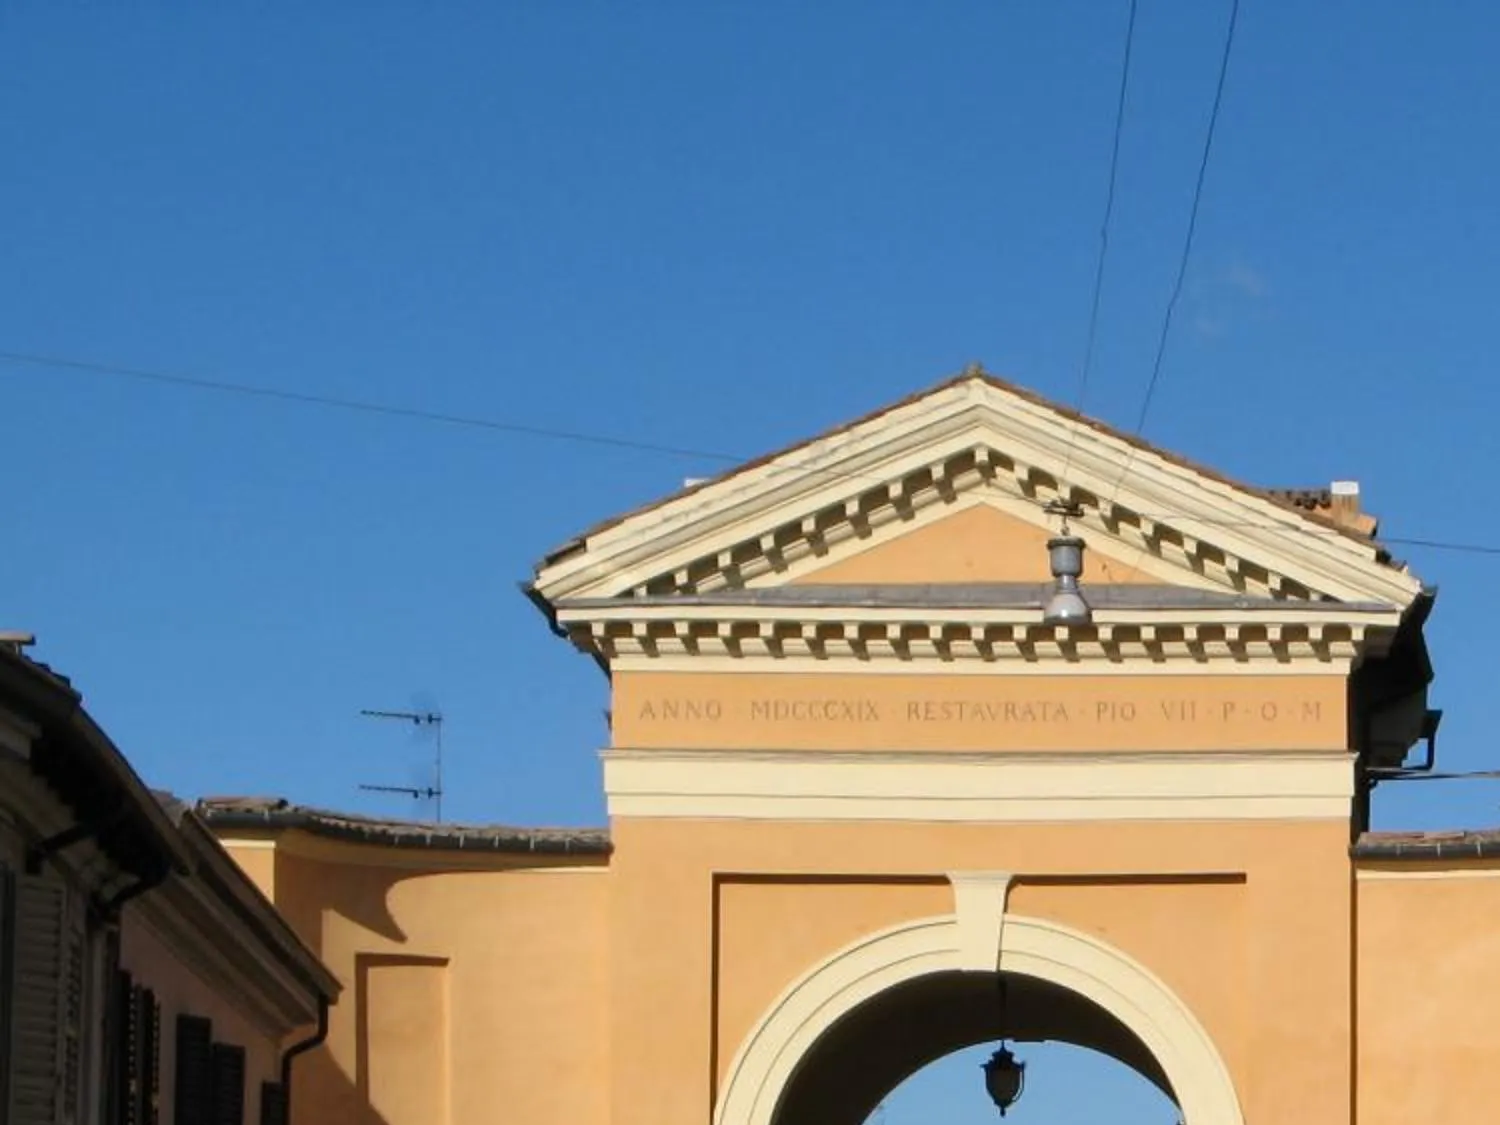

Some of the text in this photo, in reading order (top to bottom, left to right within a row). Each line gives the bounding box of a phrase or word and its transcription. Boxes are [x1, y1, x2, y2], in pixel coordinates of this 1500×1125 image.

[639, 699, 723, 721] ANNO
[749, 699, 881, 722] MDCCCXIX
[1095, 701, 1137, 722] PIO
[1160, 701, 1197, 722] VII
[1221, 701, 1236, 722] P
[1260, 701, 1278, 722] O
[1301, 701, 1322, 722] M
